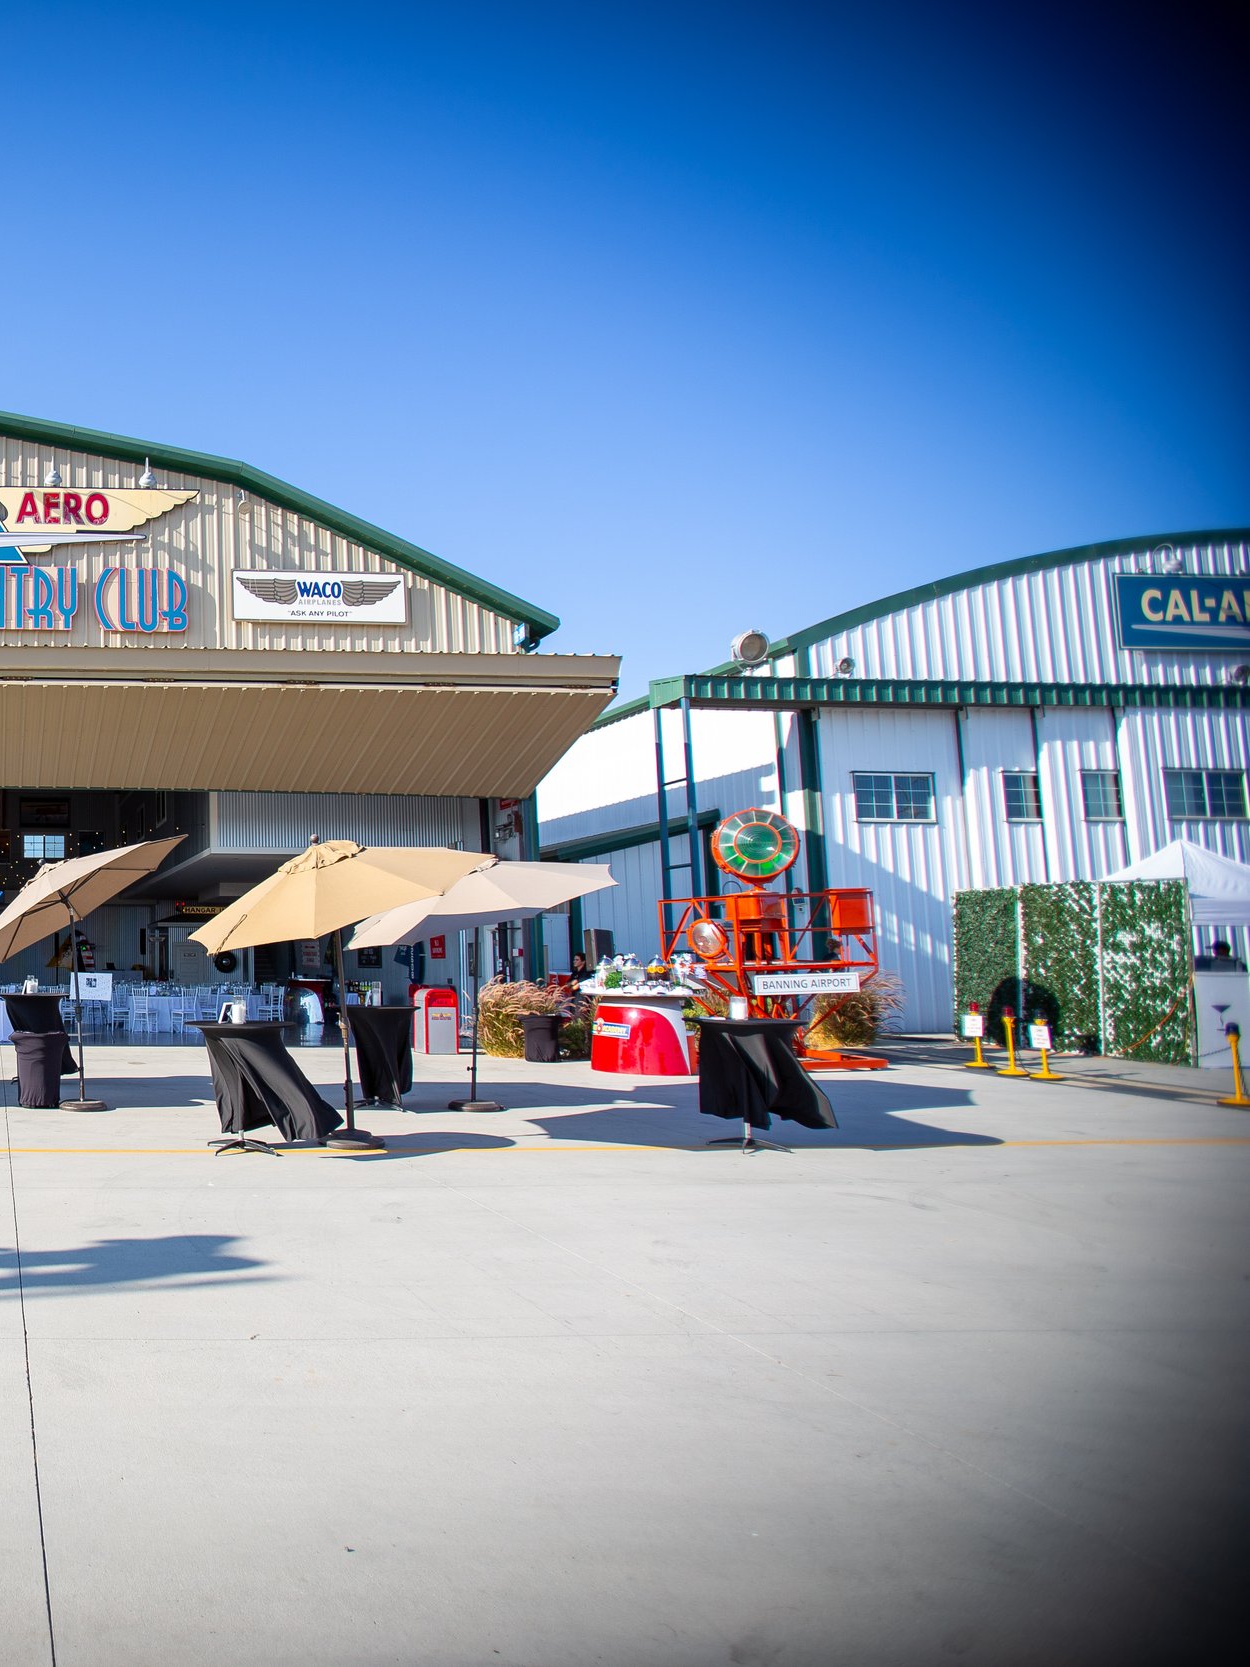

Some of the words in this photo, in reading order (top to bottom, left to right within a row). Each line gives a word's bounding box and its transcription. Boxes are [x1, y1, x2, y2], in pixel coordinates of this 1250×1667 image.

[15, 491, 111, 527] AERO
[95, 566, 190, 633] CLUB
[297, 581, 342, 599] WACO
[1140, 589, 1250, 623] CAL-A
[762, 979, 808, 990] BANNING
[810, 978, 852, 988] AIRPORT
